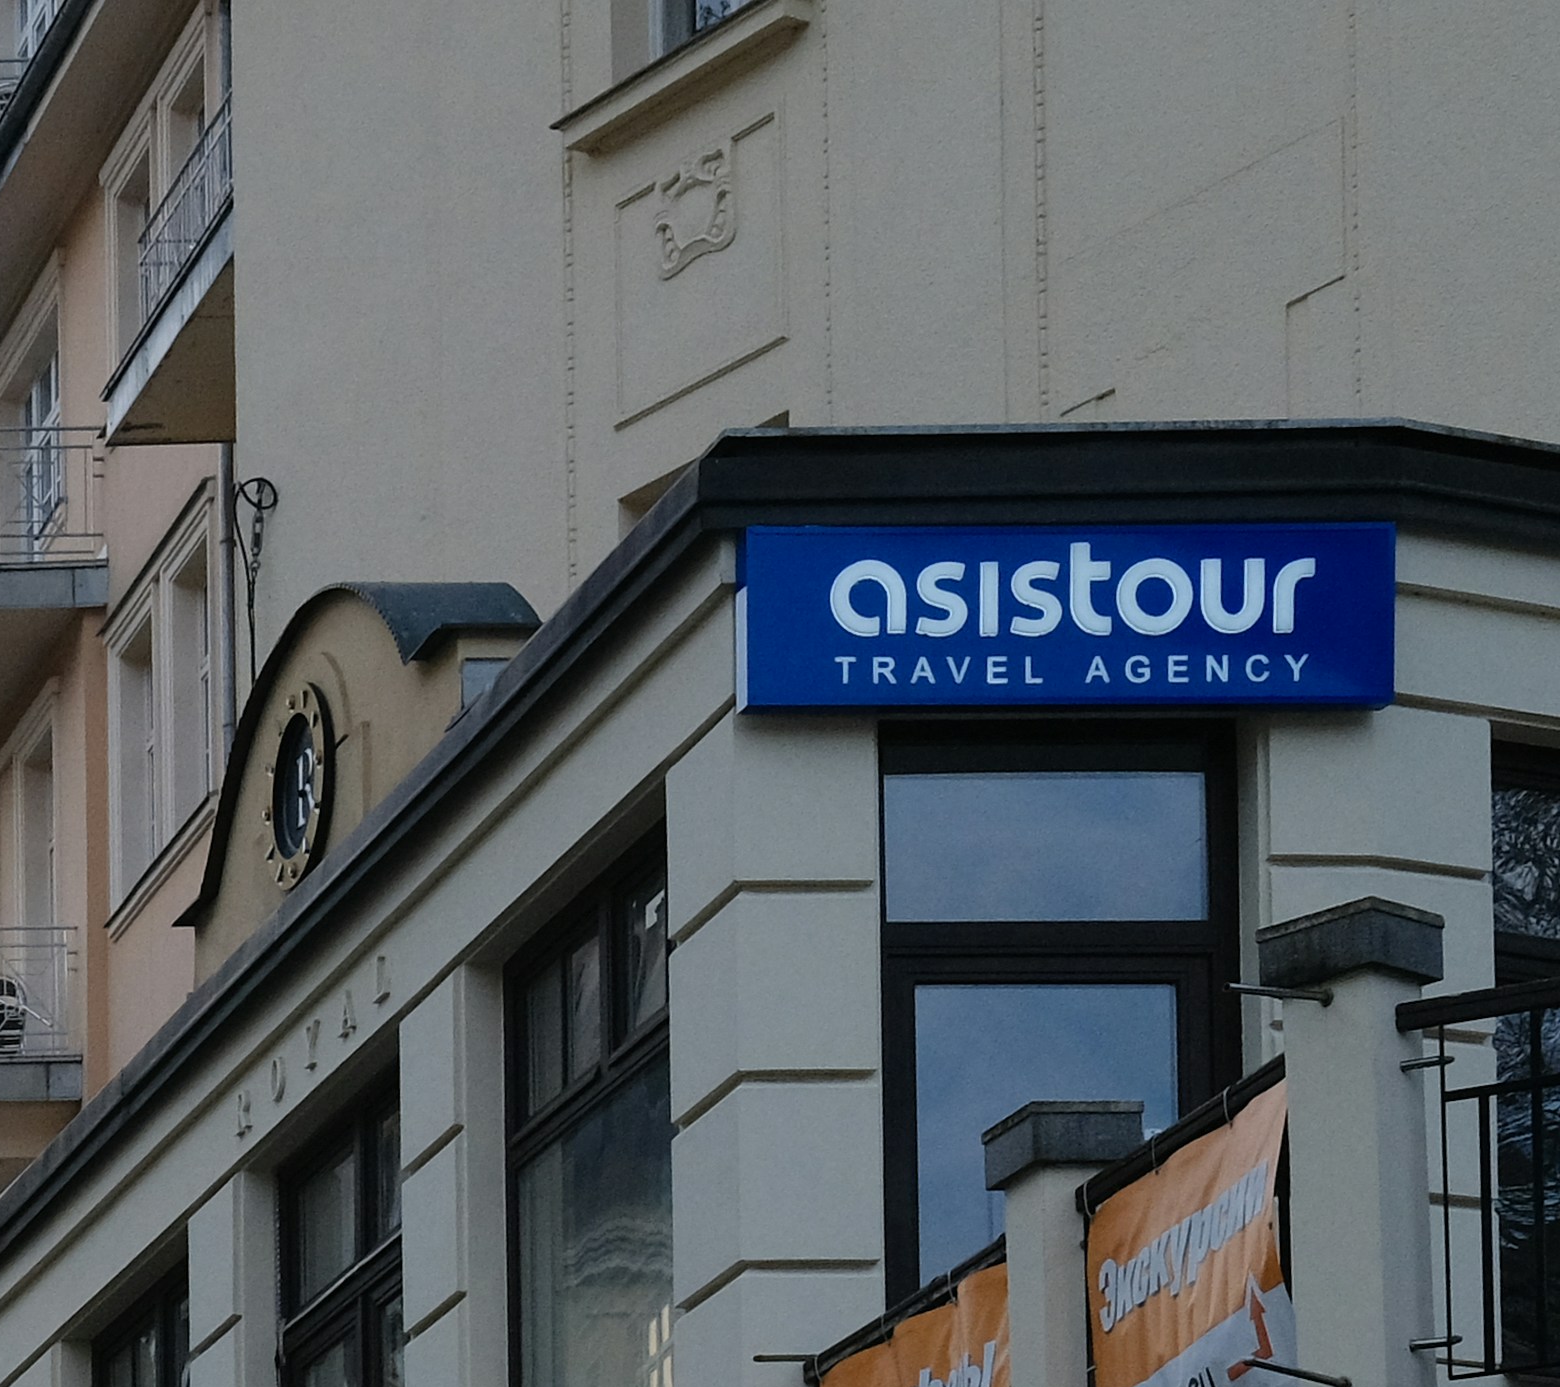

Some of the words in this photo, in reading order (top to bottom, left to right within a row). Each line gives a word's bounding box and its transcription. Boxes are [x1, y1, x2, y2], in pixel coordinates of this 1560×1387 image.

[828, 541, 1317, 637] asistour
[834, 654, 1045, 685] TRAVEL
[1085, 653, 1311, 684] AGENCY
[234, 954, 392, 1139] ROYAL
